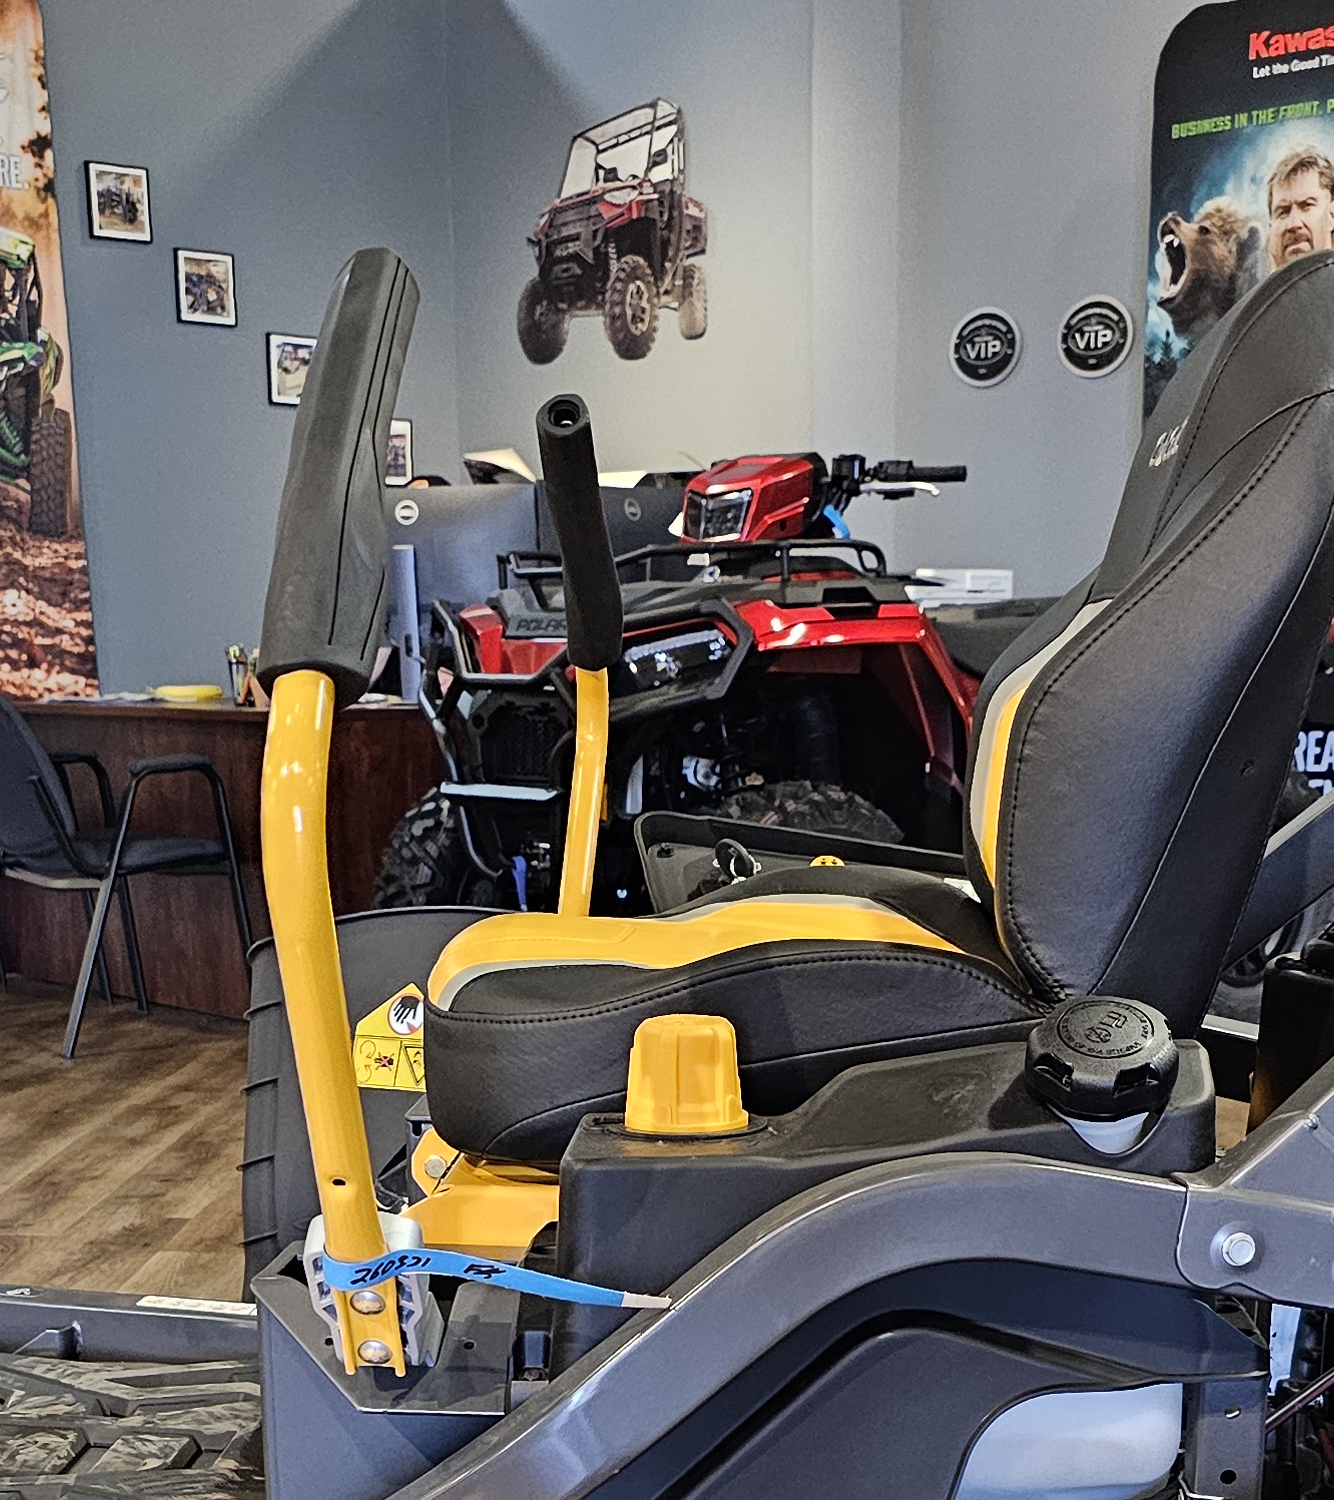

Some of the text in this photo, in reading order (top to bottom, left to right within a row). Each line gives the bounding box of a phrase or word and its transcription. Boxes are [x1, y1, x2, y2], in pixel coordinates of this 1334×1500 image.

[1253, 65, 1271, 78] Let
[1272, 62, 1289, 75] the
[1291, 58, 1320, 72] Good
[1171, 115, 1233, 139] BUSINESS
[1235, 112, 1249, 128] IN
[1252, 107, 1277, 126] THE
[1278, 100, 1323, 123] FRONT.
[966, 339, 1002, 360] VIP
[1074, 329, 1113, 350] VIP
